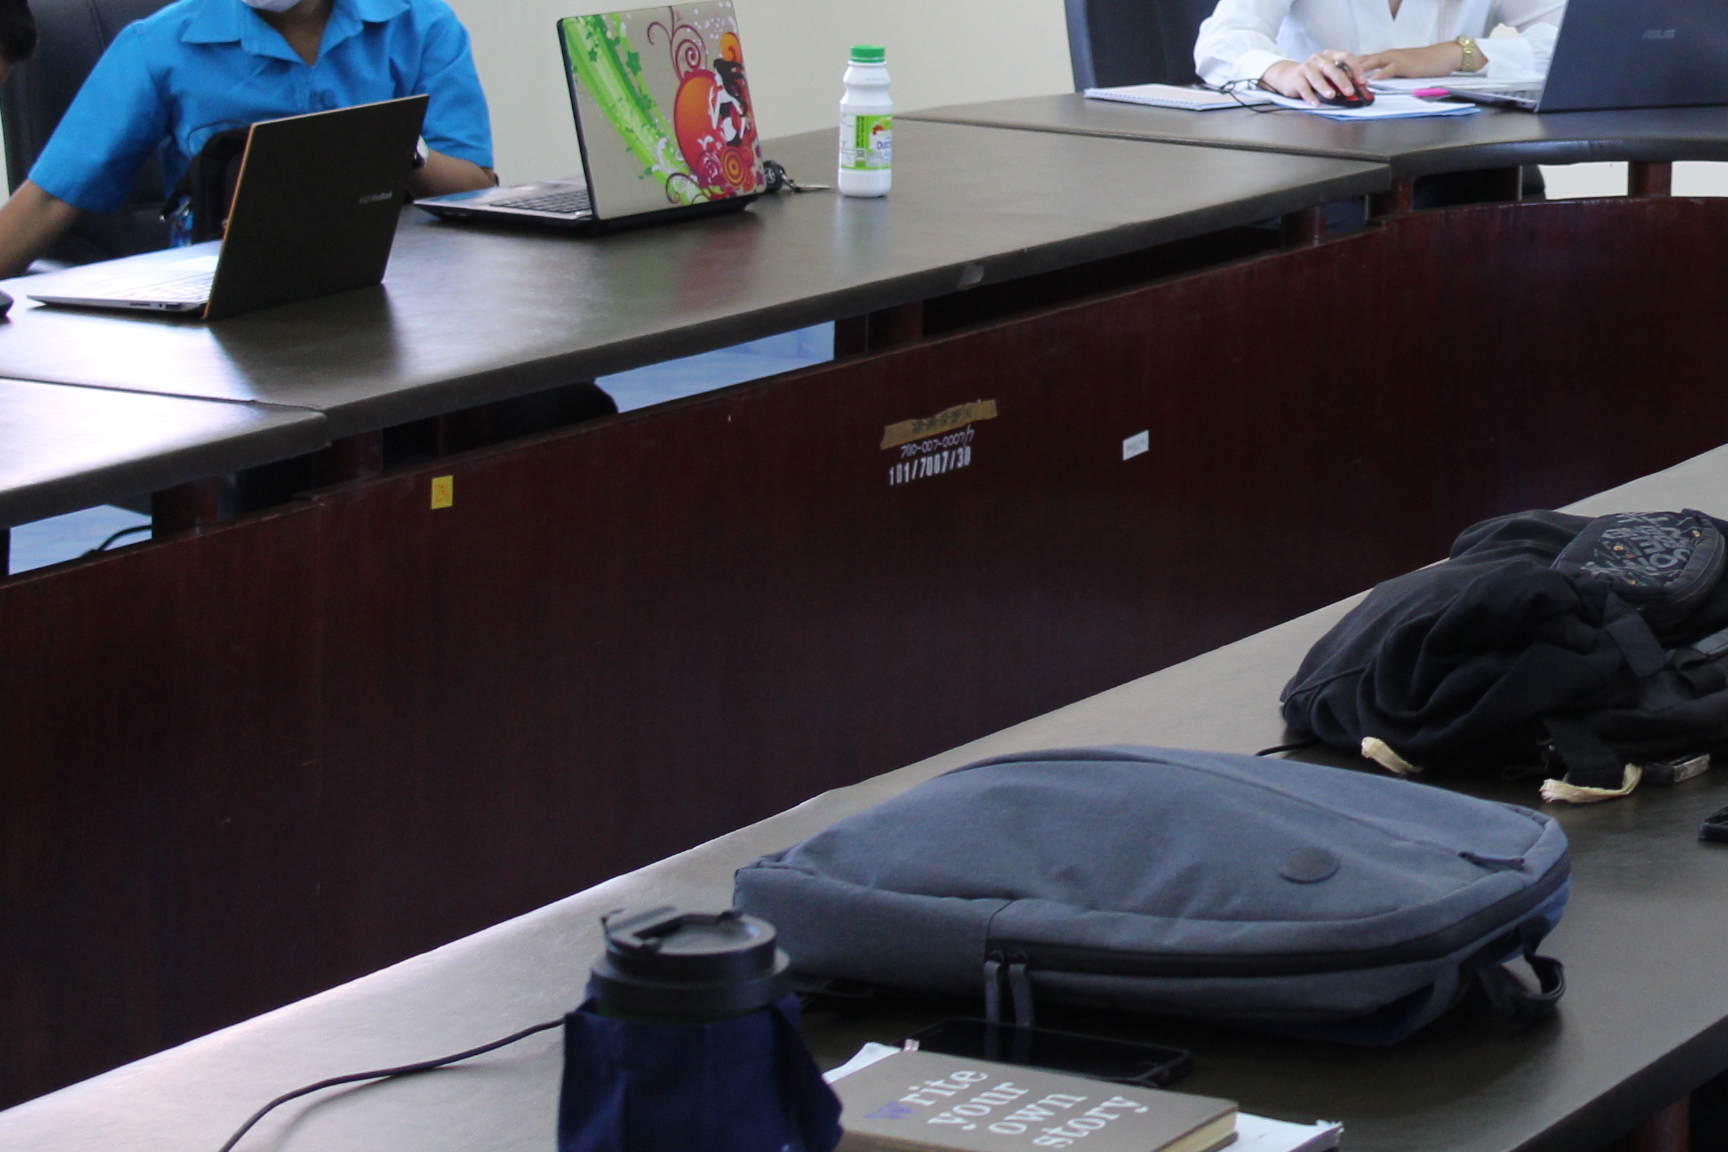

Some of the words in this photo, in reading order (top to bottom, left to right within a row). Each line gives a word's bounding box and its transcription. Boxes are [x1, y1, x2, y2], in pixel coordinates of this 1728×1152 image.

[927, 1081, 1029, 1131] your
[987, 1093, 1088, 1135] own
[1032, 1095, 1149, 1148] story
